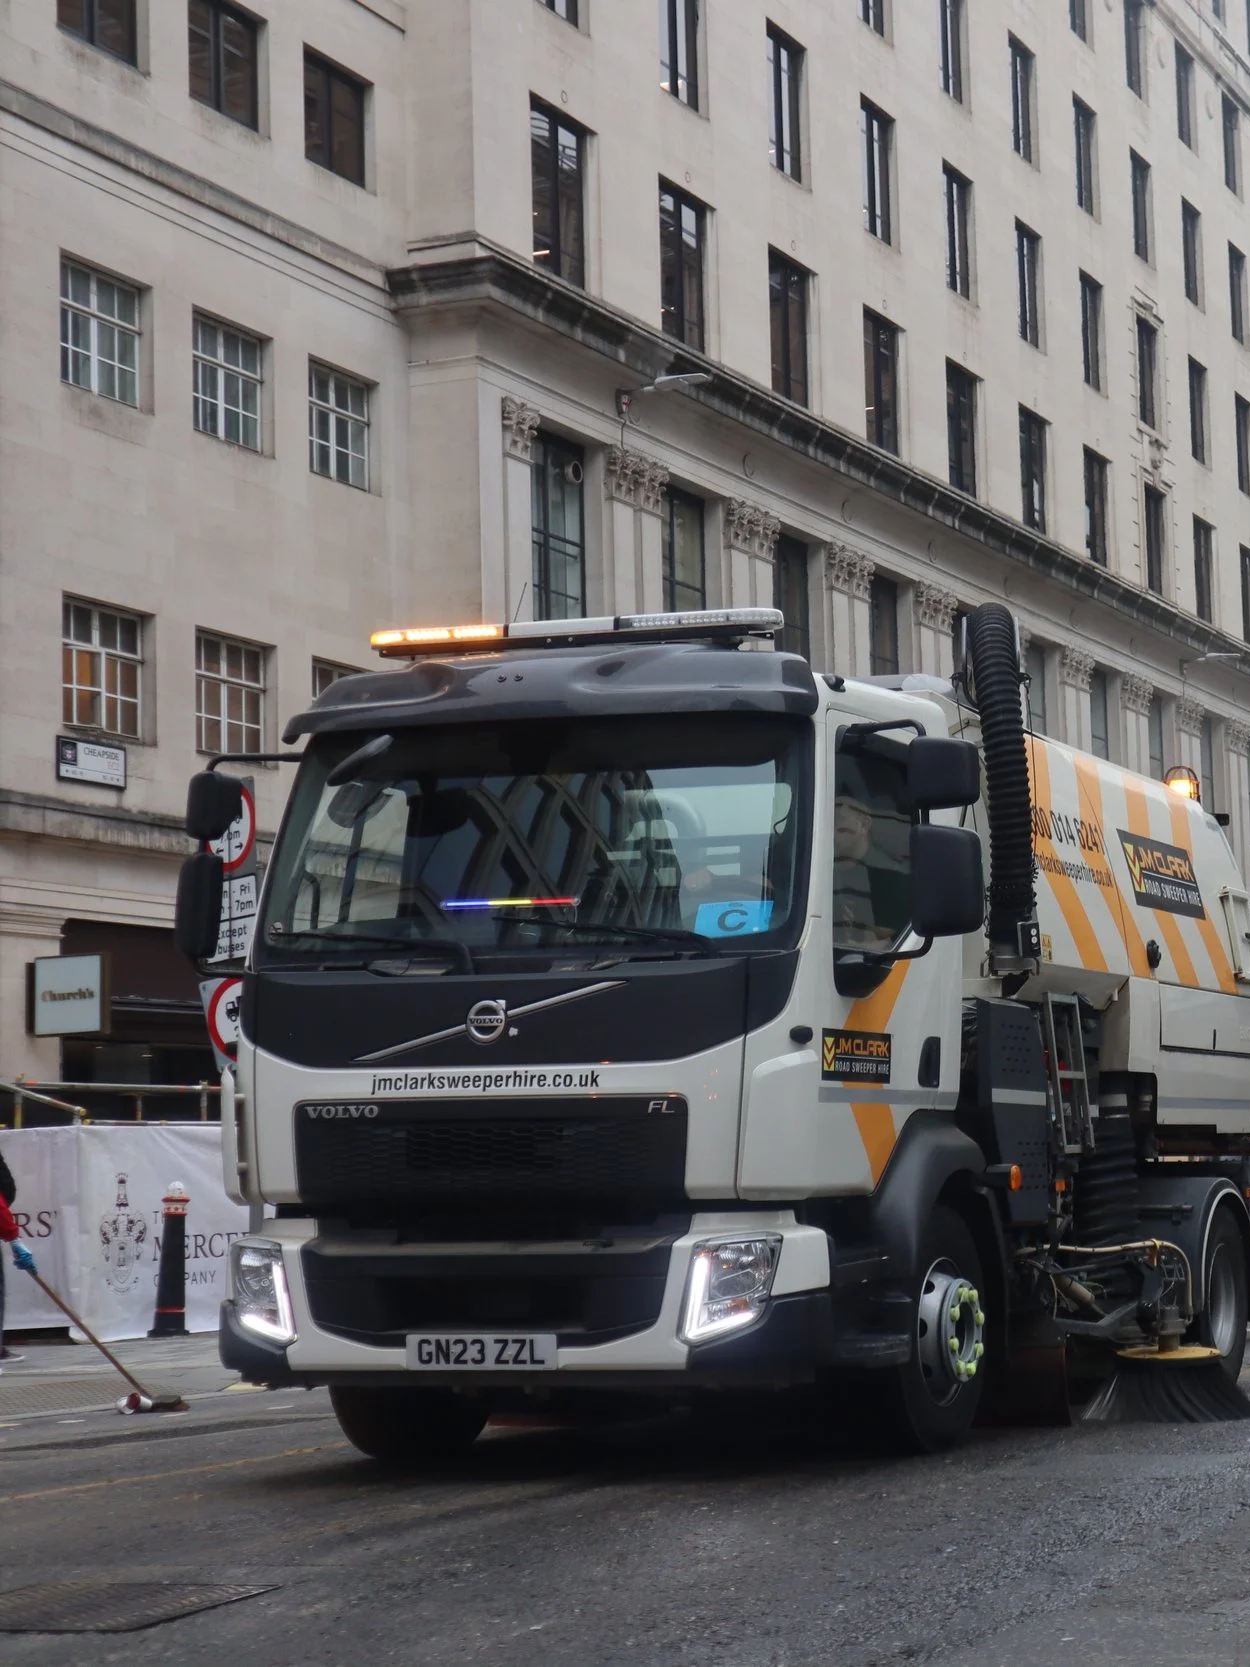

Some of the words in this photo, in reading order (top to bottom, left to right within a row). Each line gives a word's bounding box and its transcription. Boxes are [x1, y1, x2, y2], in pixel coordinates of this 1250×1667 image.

[83, 747, 120, 761] CHEAPSIDE
[1050, 810, 1076, 847] 014
[1073, 817, 1105, 855] 6241
[1139, 846, 1156, 871] JM
[1153, 851, 1195, 882] CLARK
[240, 882, 251, 896] Fri
[1144, 879, 1161, 897] ROAD
[1161, 883, 1189, 903] SWEEPER
[1186, 889, 1201, 907] HIRE
[235, 899, 254, 913] 7pm
[717, 909, 749, 932] C
[217, 924, 247, 940] xcept
[41, 987, 95, 1002] Church's
[836, 1038, 852, 1054] JM
[853, 1039, 889, 1057] CLARK
[834, 1061, 850, 1072] ROAD
[851, 1062, 877, 1074] SWEEPER
[877, 1064, 890, 1075] HIRE
[371, 1071, 600, 1096] jmclarksweeperhire.co.uk
[305, 1104, 379, 1120] VOLVO
[647, 1099, 675, 1114] FL
[417, 1339, 486, 1365] GN23
[493, 1339, 546, 1365] ZZL
